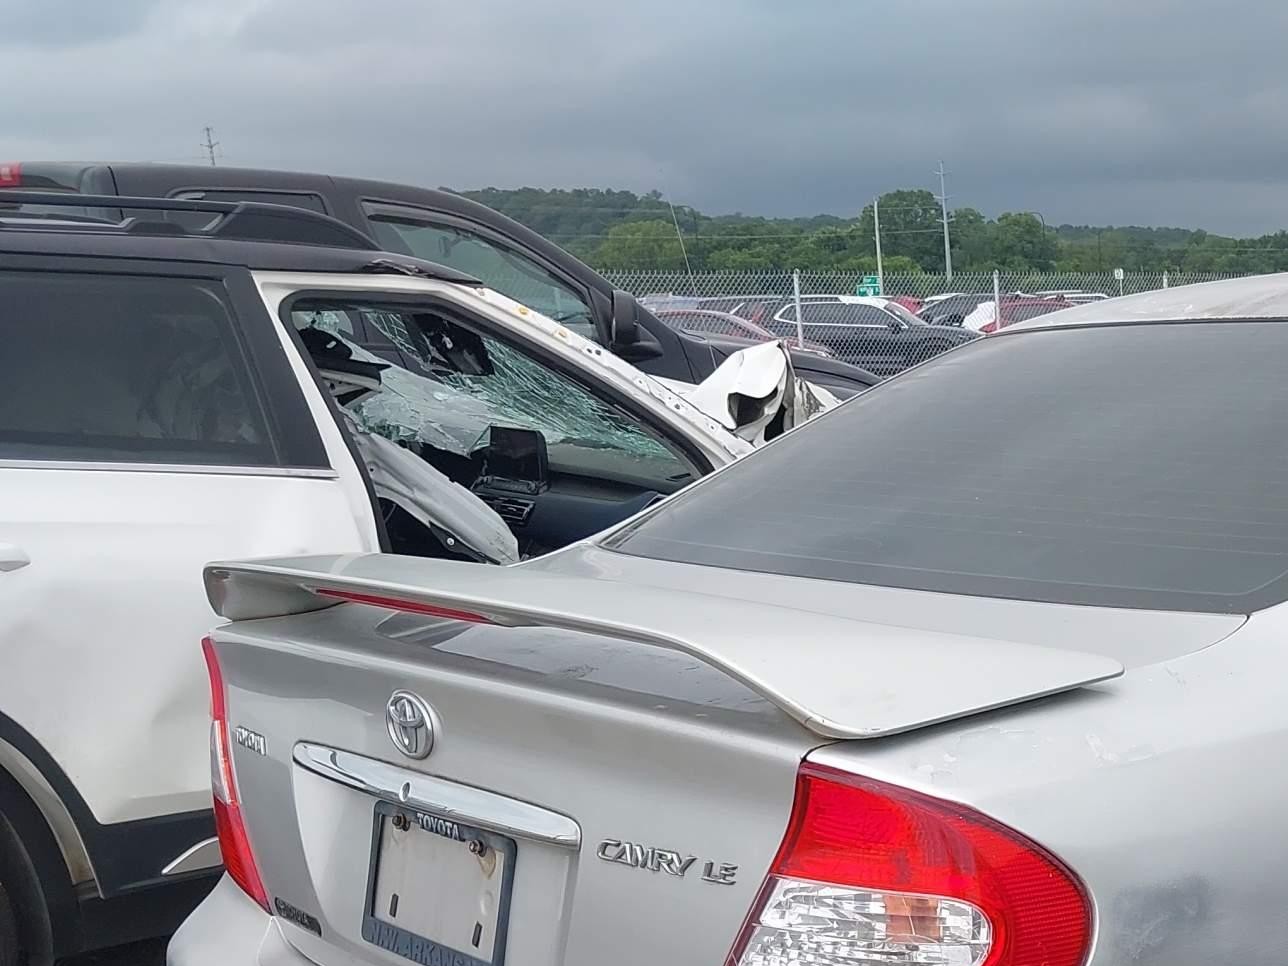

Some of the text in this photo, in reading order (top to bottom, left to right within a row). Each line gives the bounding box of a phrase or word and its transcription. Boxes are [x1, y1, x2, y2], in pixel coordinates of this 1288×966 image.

[416, 812, 462, 842] TOYOTA
[597, 838, 739, 886] CAMRY LE
